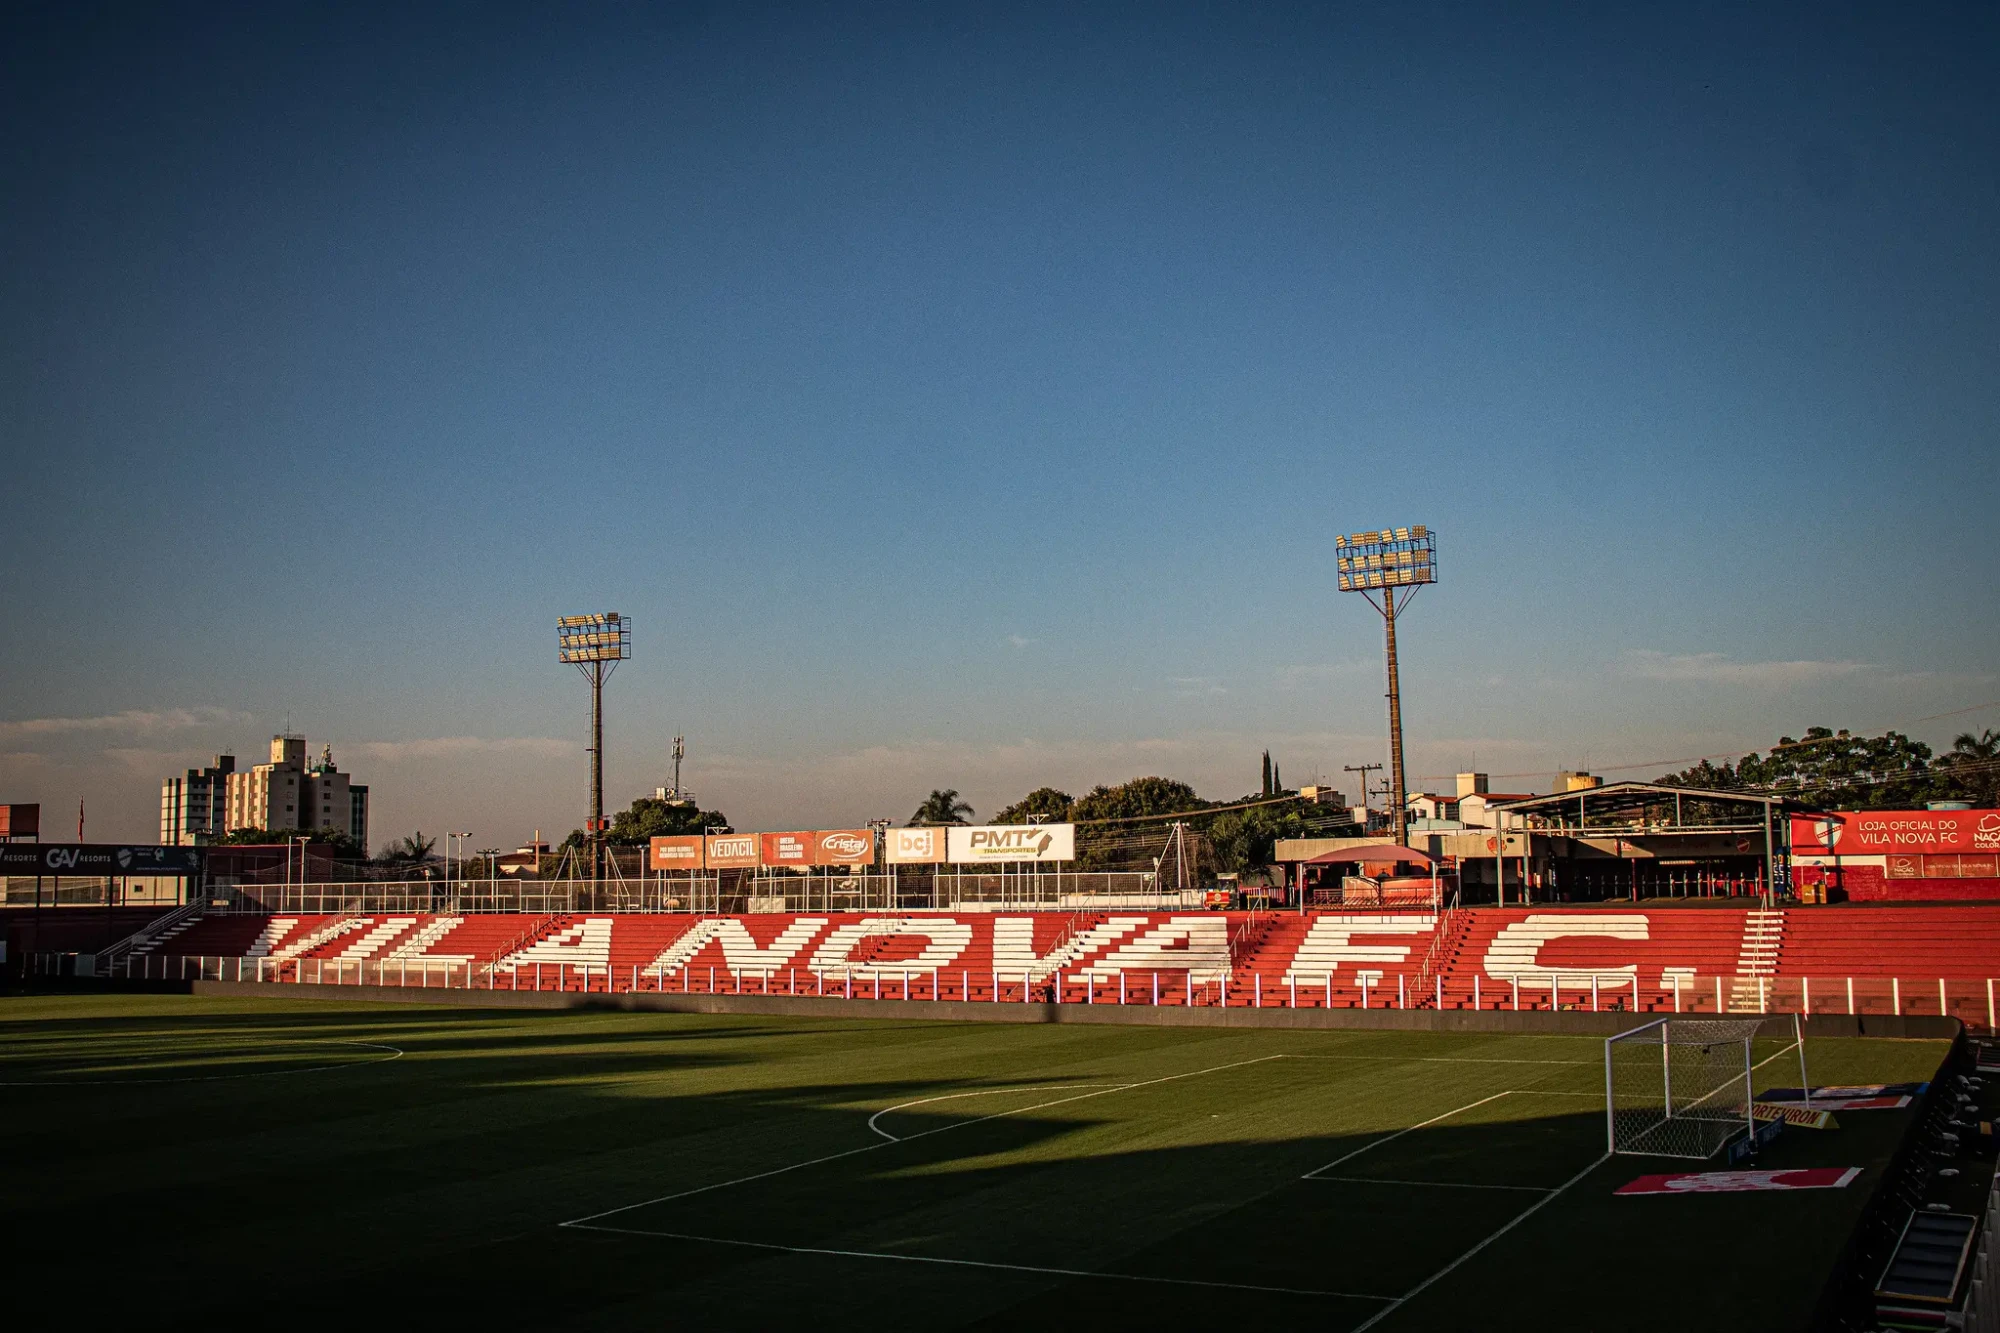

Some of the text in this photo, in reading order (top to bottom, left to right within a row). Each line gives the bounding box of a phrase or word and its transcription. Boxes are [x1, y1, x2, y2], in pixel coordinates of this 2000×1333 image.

[1858, 820, 1958, 832] LOJA OFICIAL DO
[825, 837, 866, 849] Cristal
[970, 829, 1027, 848] PMT
[1860, 832, 1958, 845] VILA NOVA FC
[709, 838, 757, 857] VEDACIL
[3, 854, 37, 862] RESORTS
[46, 848, 111, 868] GAV RESORTS
[1744, 1101, 1821, 1124] ORTEVIRON
